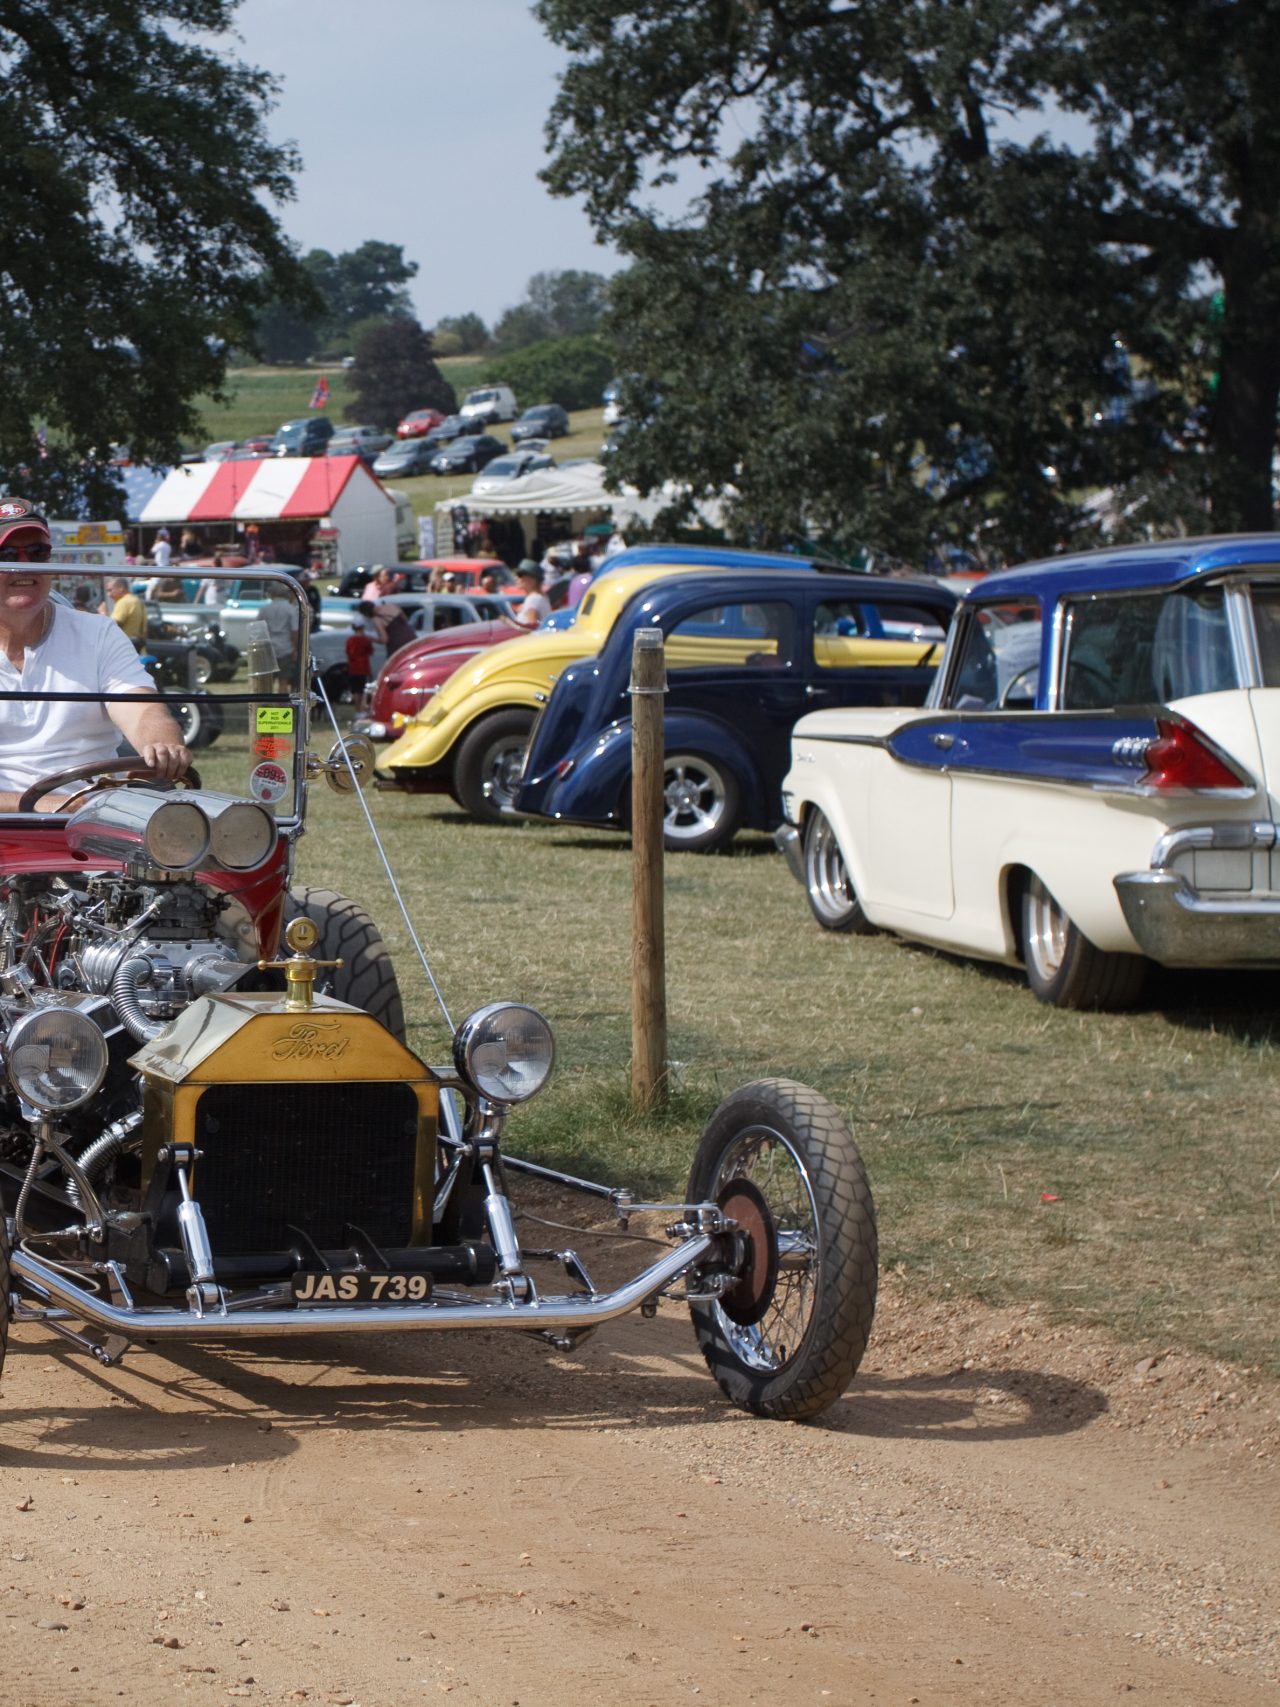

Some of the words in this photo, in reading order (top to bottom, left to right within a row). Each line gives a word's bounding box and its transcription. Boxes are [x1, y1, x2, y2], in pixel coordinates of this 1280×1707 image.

[272, 1022, 351, 1061] Ford
[295, 1275, 359, 1300] JAS
[369, 1275, 427, 1300] 739
